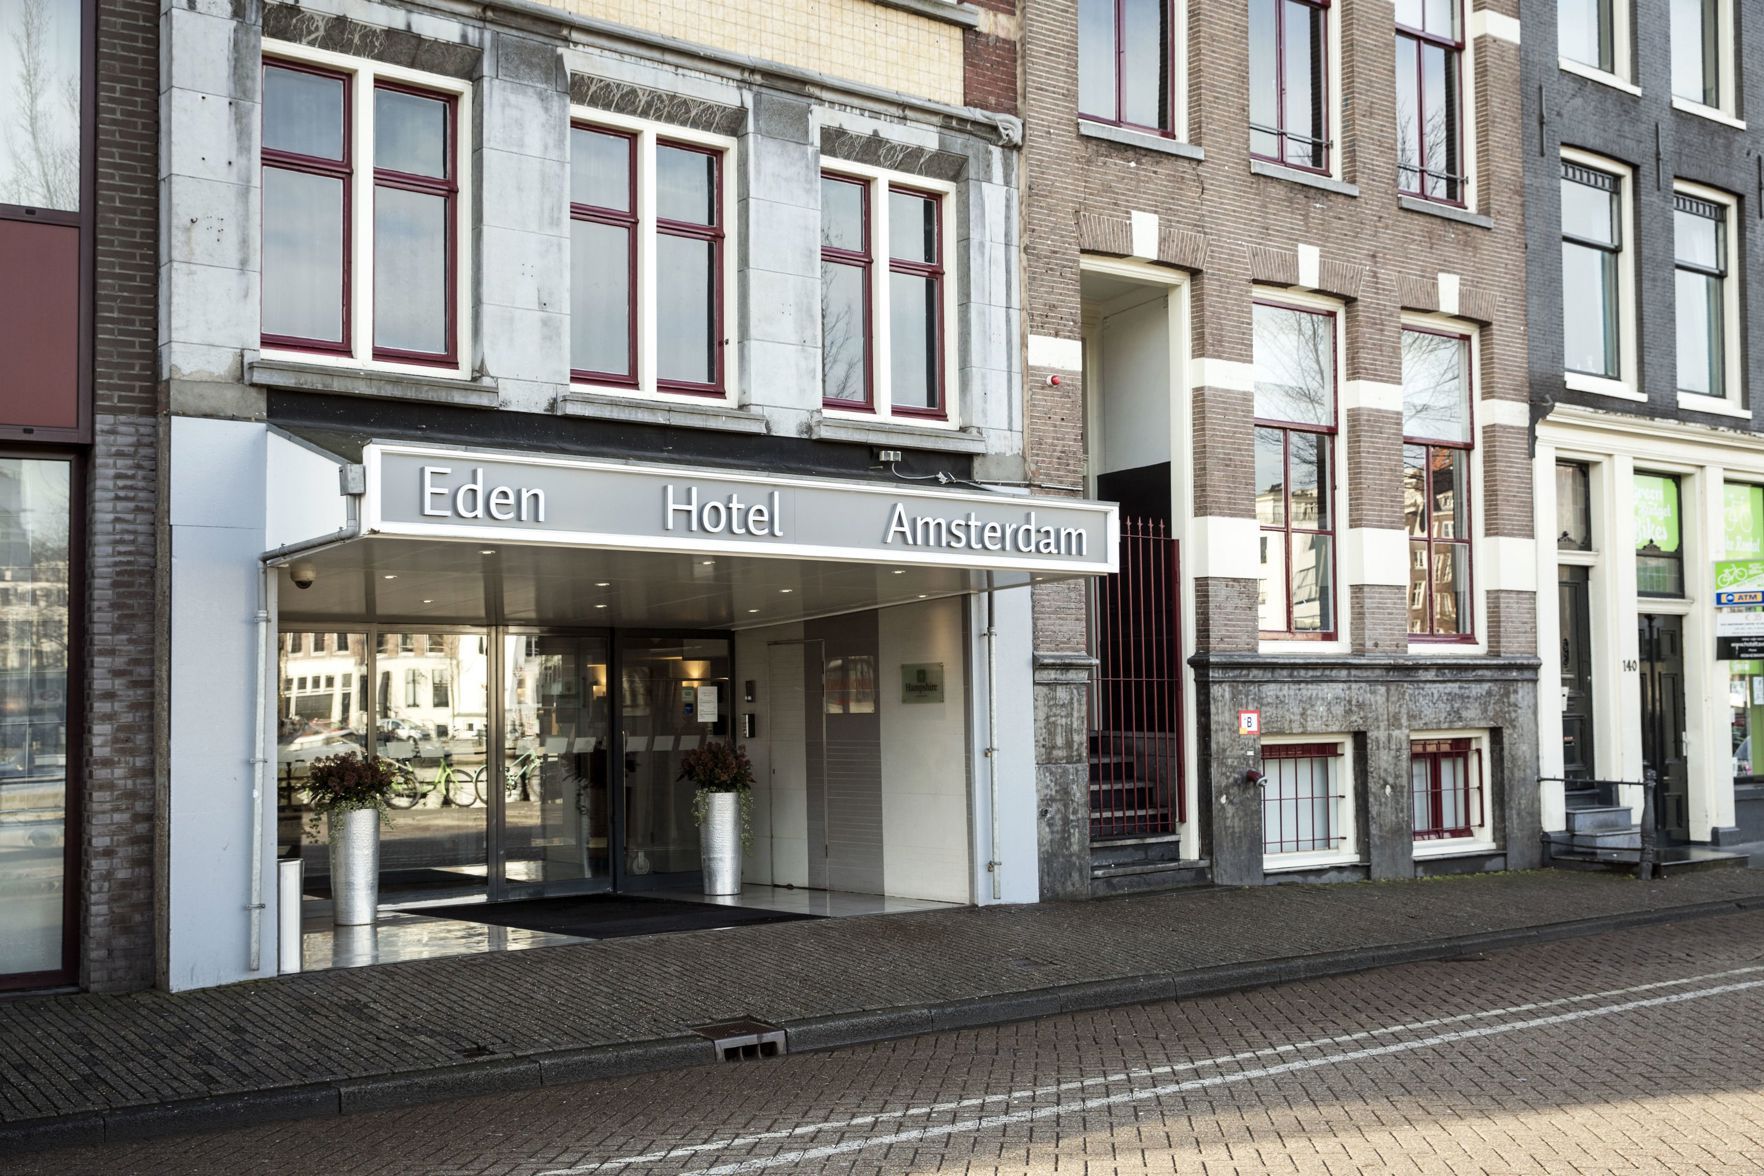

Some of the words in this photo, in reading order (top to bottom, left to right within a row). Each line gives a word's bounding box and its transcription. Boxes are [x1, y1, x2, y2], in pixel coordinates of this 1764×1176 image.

[422, 466, 546, 522] Eden
[665, 484, 784, 537] Hotel
[885, 502, 1088, 557] Amsterdam
[1737, 593, 1758, 601] ATM
[1622, 659, 1638, 672] 140
